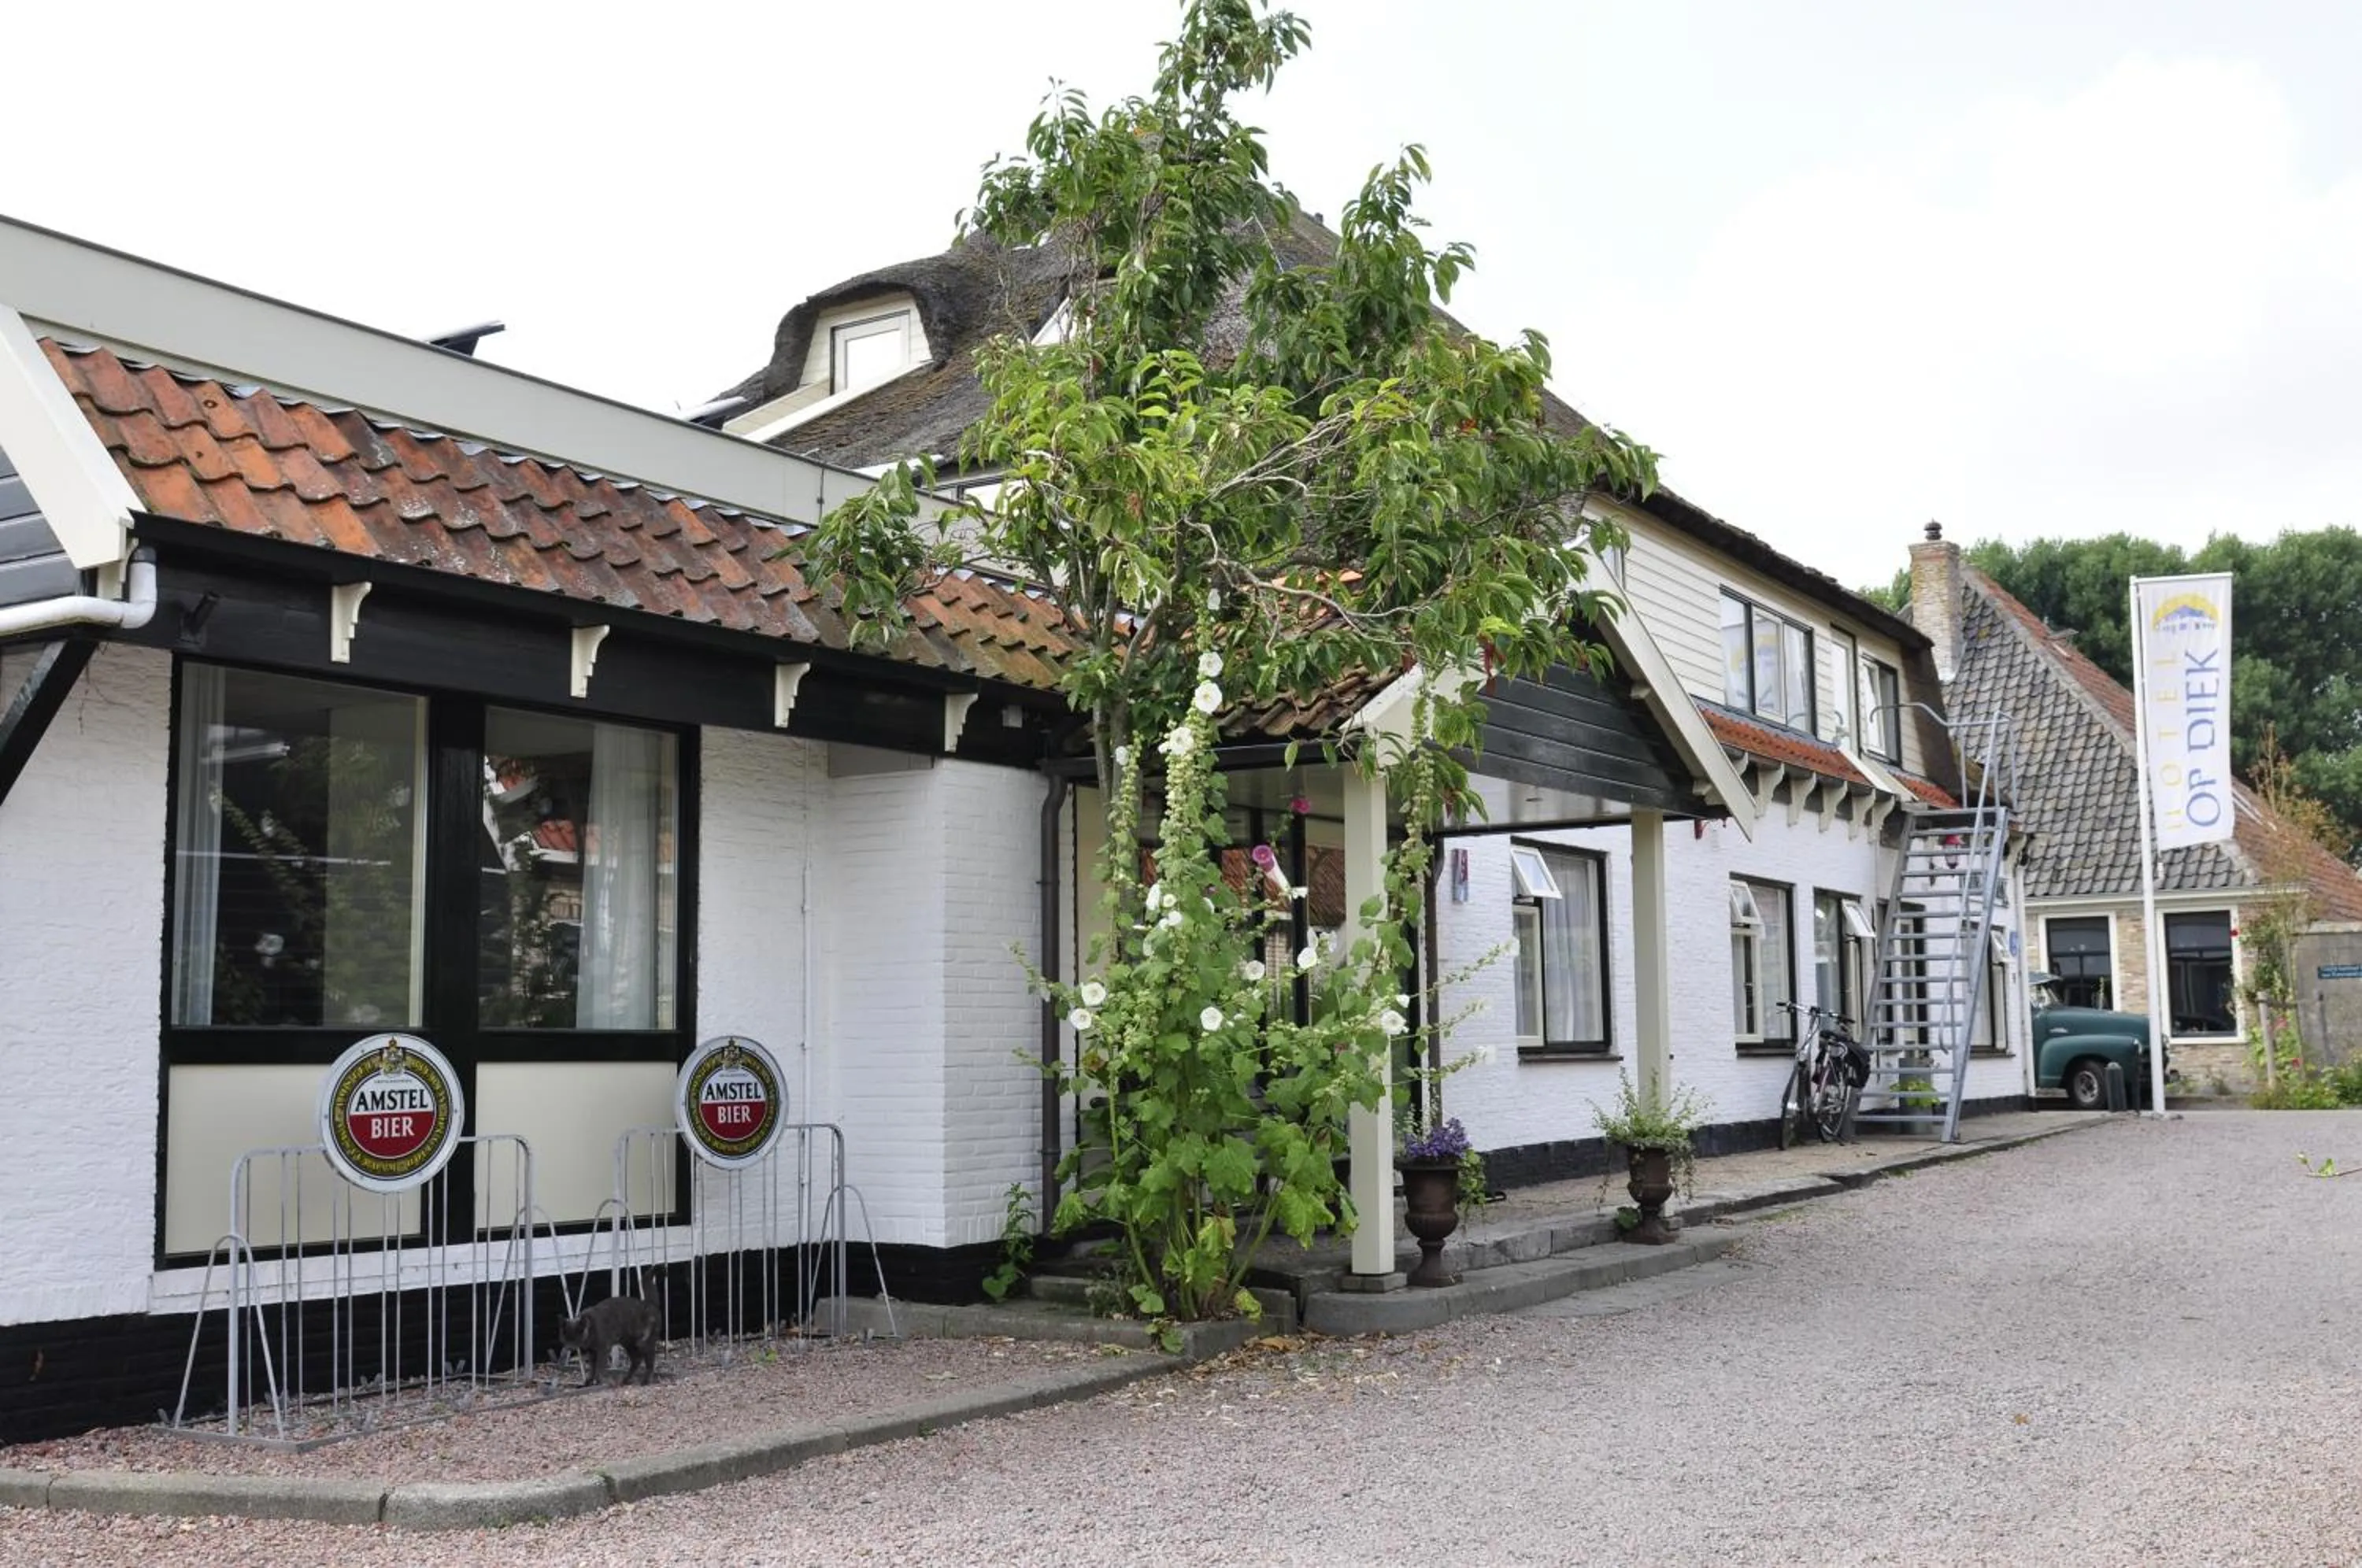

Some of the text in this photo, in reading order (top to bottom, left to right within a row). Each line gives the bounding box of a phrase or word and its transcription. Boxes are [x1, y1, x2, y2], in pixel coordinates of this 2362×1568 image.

[2184, 649, 2220, 753] DIEK
[2186, 768, 2221, 827] OP
[355, 1089, 428, 1112] AMSTEL
[705, 1082, 761, 1101] AMSTEL
[717, 1104, 752, 1123] BIER
[371, 1116, 415, 1139] BIER
